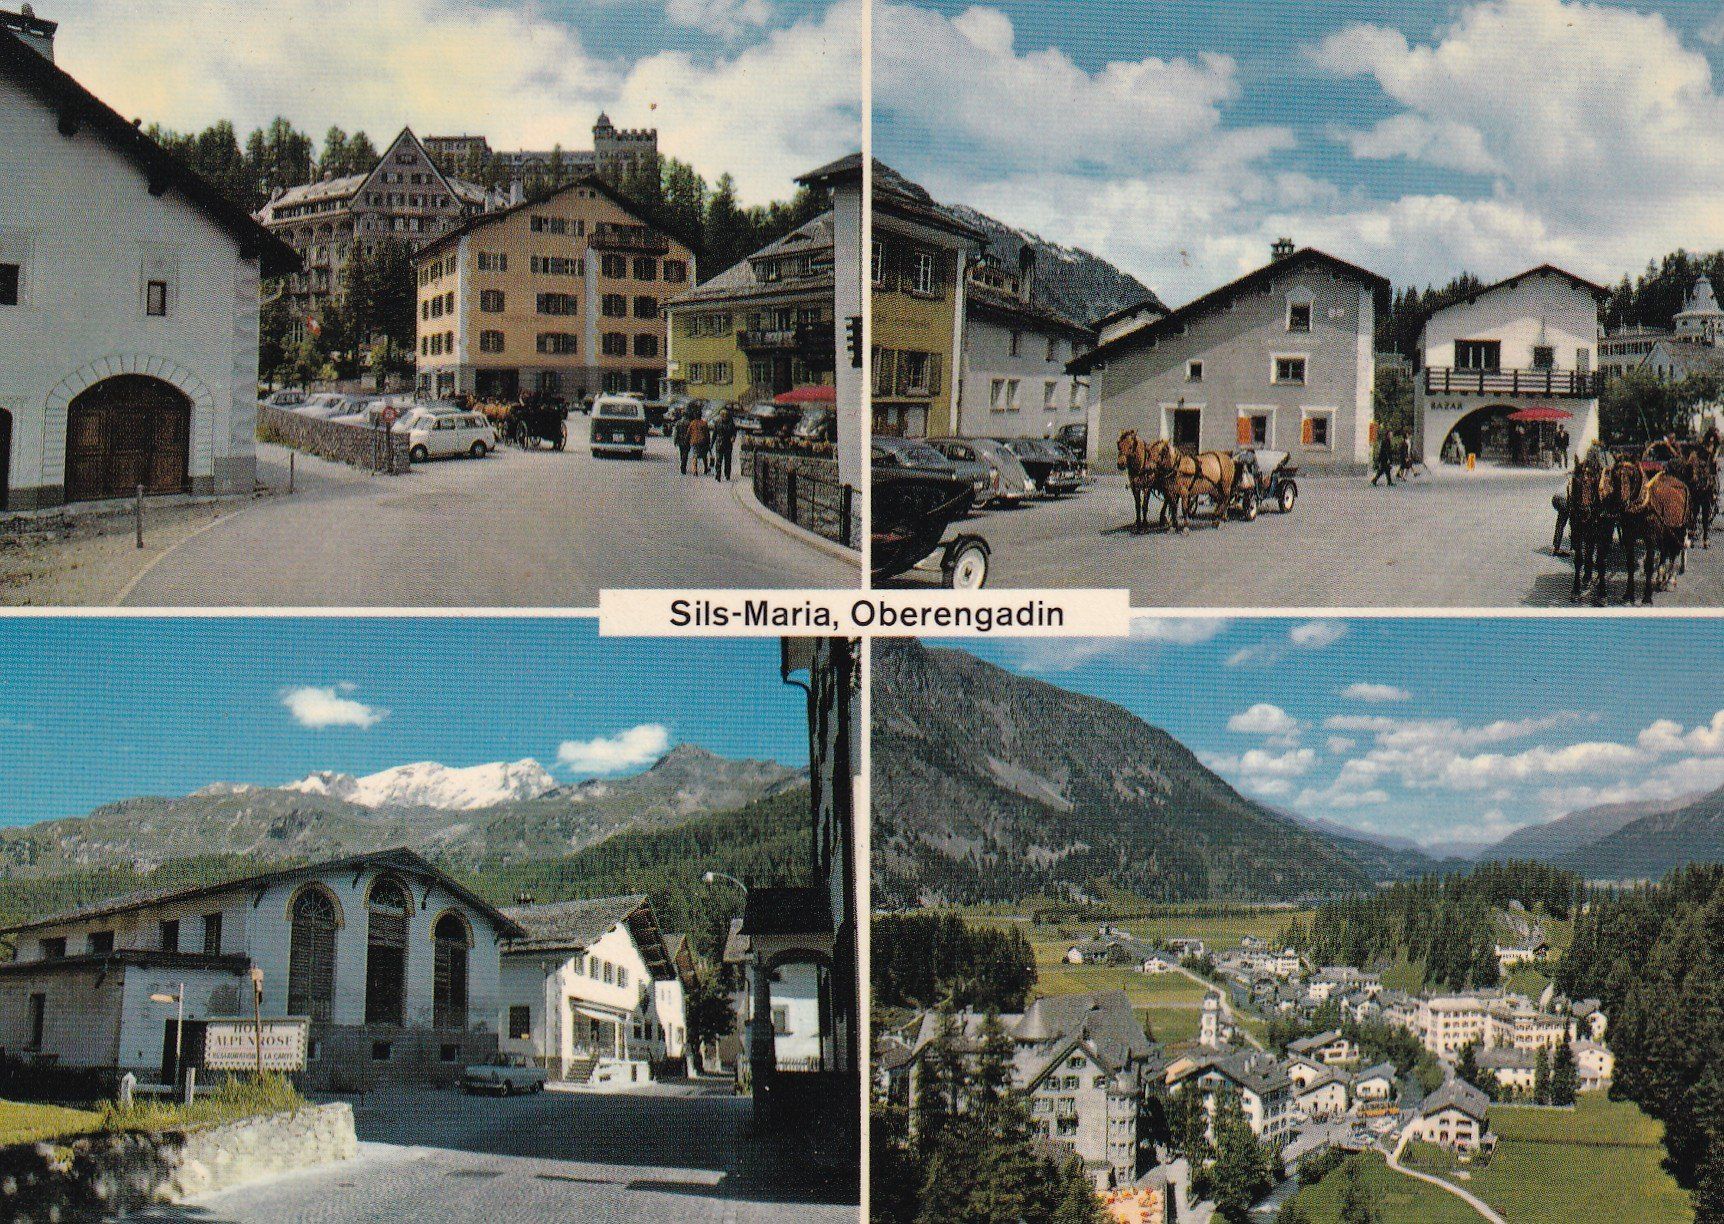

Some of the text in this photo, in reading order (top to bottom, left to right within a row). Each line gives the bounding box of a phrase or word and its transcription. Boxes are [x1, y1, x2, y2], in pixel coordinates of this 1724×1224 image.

[1430, 401, 1463, 410] BAZAR
[233, 1022, 274, 1034] HOTEL
[216, 1035, 293, 1046] ALPENROSE
